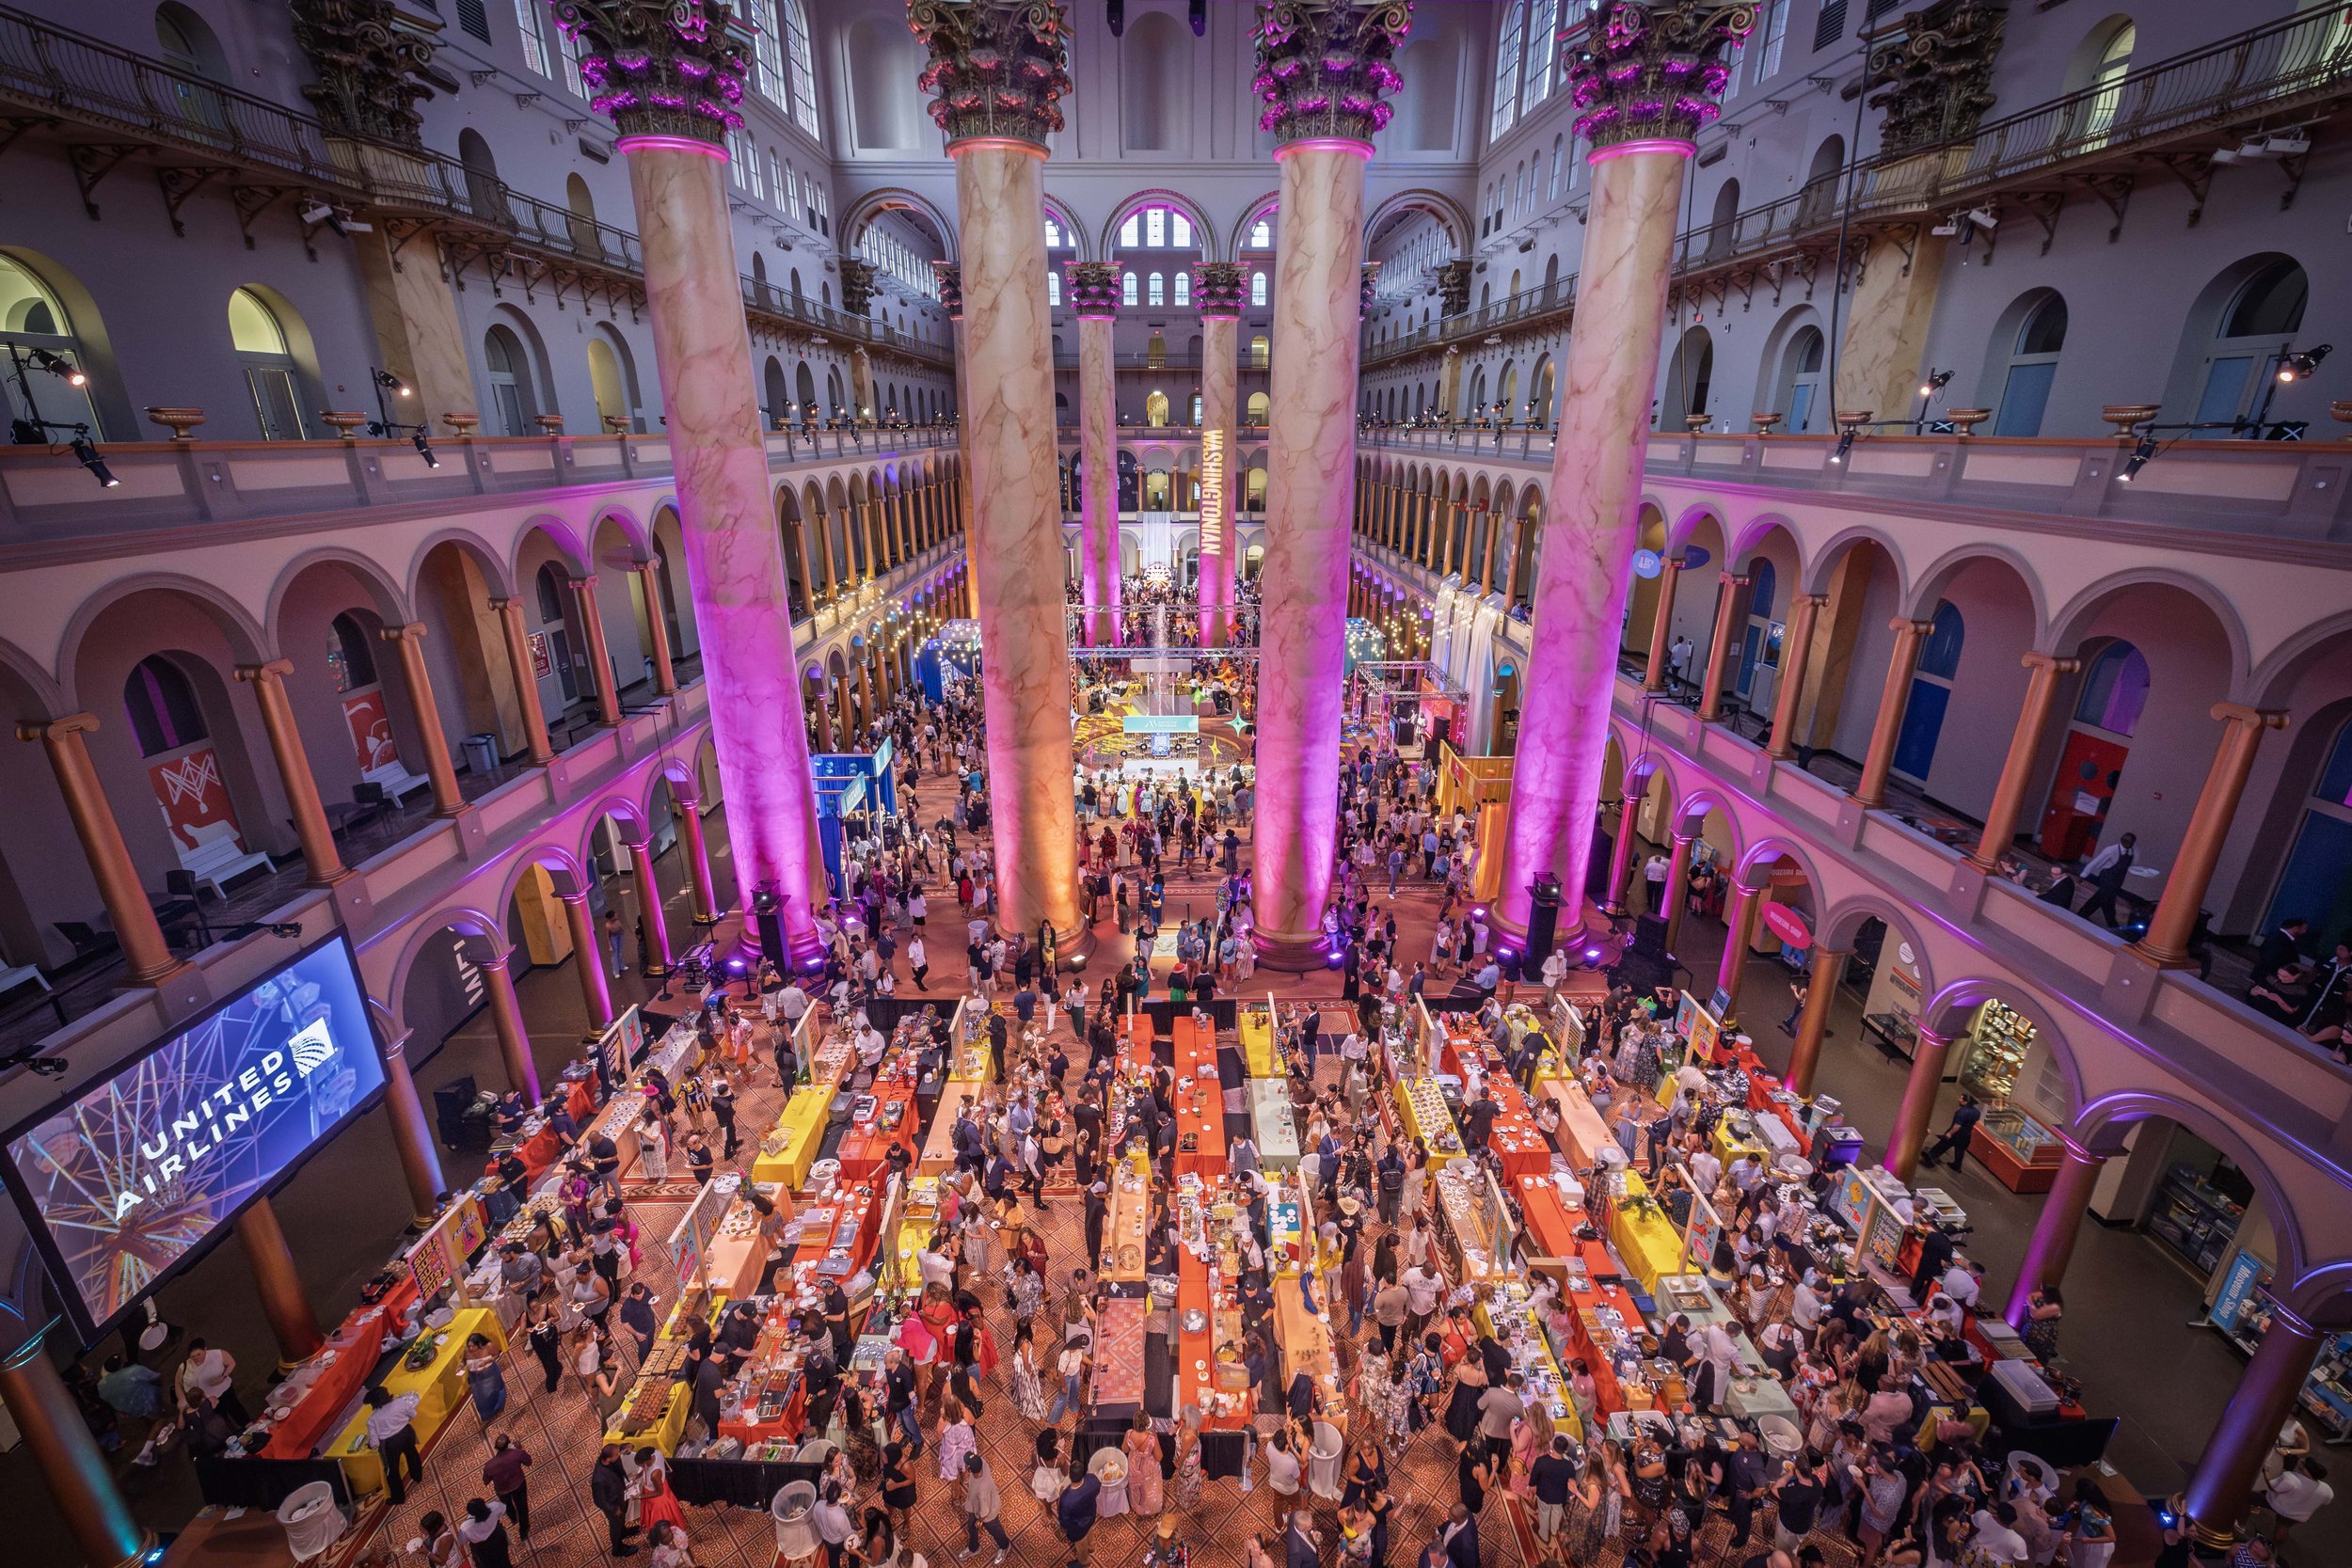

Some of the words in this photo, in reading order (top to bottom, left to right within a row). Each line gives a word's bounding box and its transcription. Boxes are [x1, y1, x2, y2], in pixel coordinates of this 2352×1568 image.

[1201, 429, 1224, 555] WASHINGTONIAN
[141, 1050, 284, 1162] UNITED
[115, 1070, 293, 1221] AIRLINES
[453, 1211, 478, 1243] AGORA
[2218, 1296, 2237, 1320] Shop
[2229, 1264, 2252, 1299] Museum
